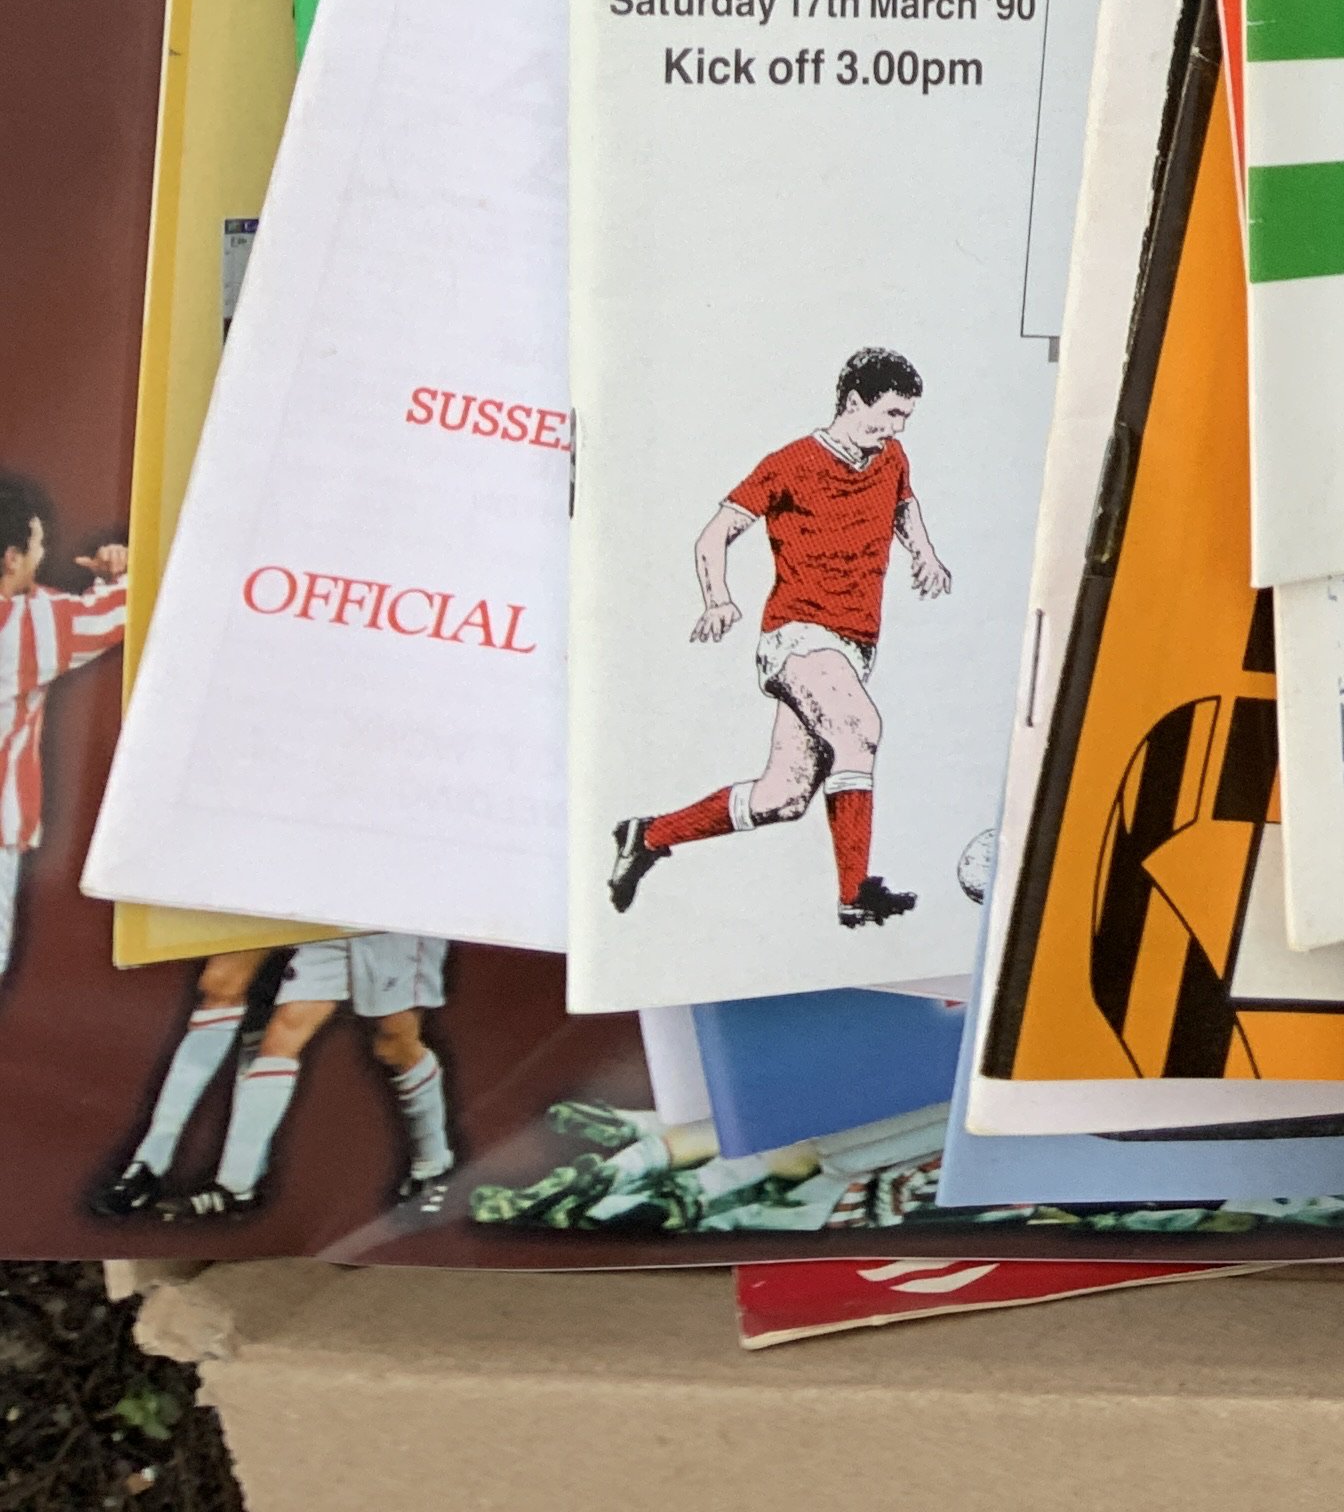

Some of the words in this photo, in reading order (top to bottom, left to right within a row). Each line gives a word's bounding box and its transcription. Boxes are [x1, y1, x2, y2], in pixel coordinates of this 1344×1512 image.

[664, 47, 756, 86] Kick
[768, 48, 825, 86] off
[836, 50, 984, 95] 3.00pm
[406, 387, 572, 451] SUSSE
[243, 566, 537, 654] OFFICIAL
